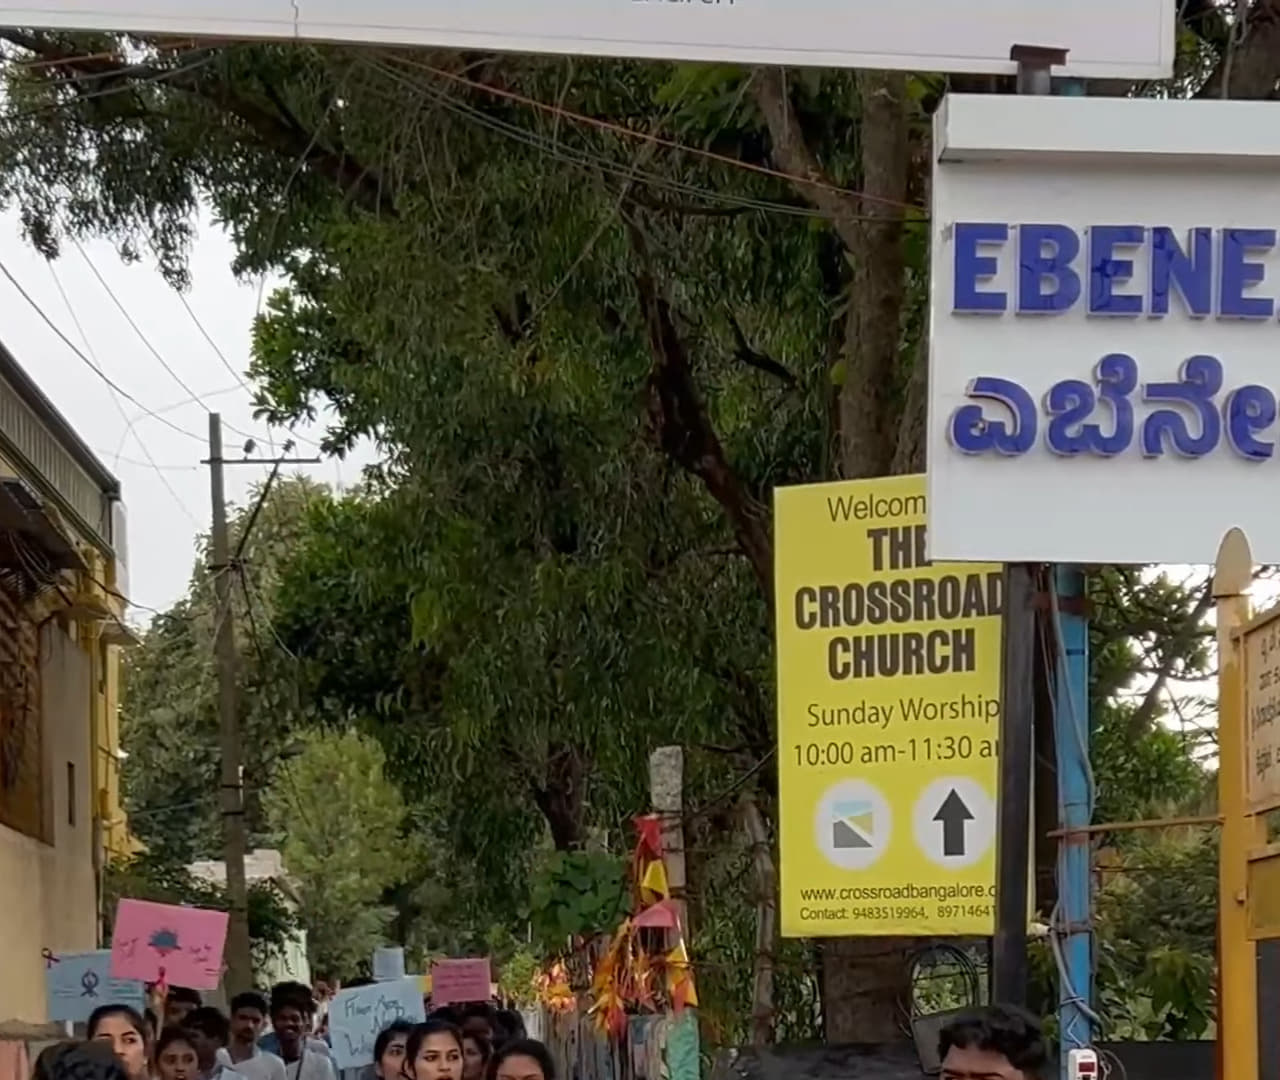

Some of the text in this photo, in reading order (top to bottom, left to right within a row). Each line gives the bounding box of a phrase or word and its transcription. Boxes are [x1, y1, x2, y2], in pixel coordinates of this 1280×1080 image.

[827, 493, 927, 522] Welcom
[867, 524, 934, 571] THE
[828, 628, 976, 681] CHURCH
[807, 694, 1001, 730] Sunday Worship
[794, 735, 1000, 767] 10:00 am-11:30 a
